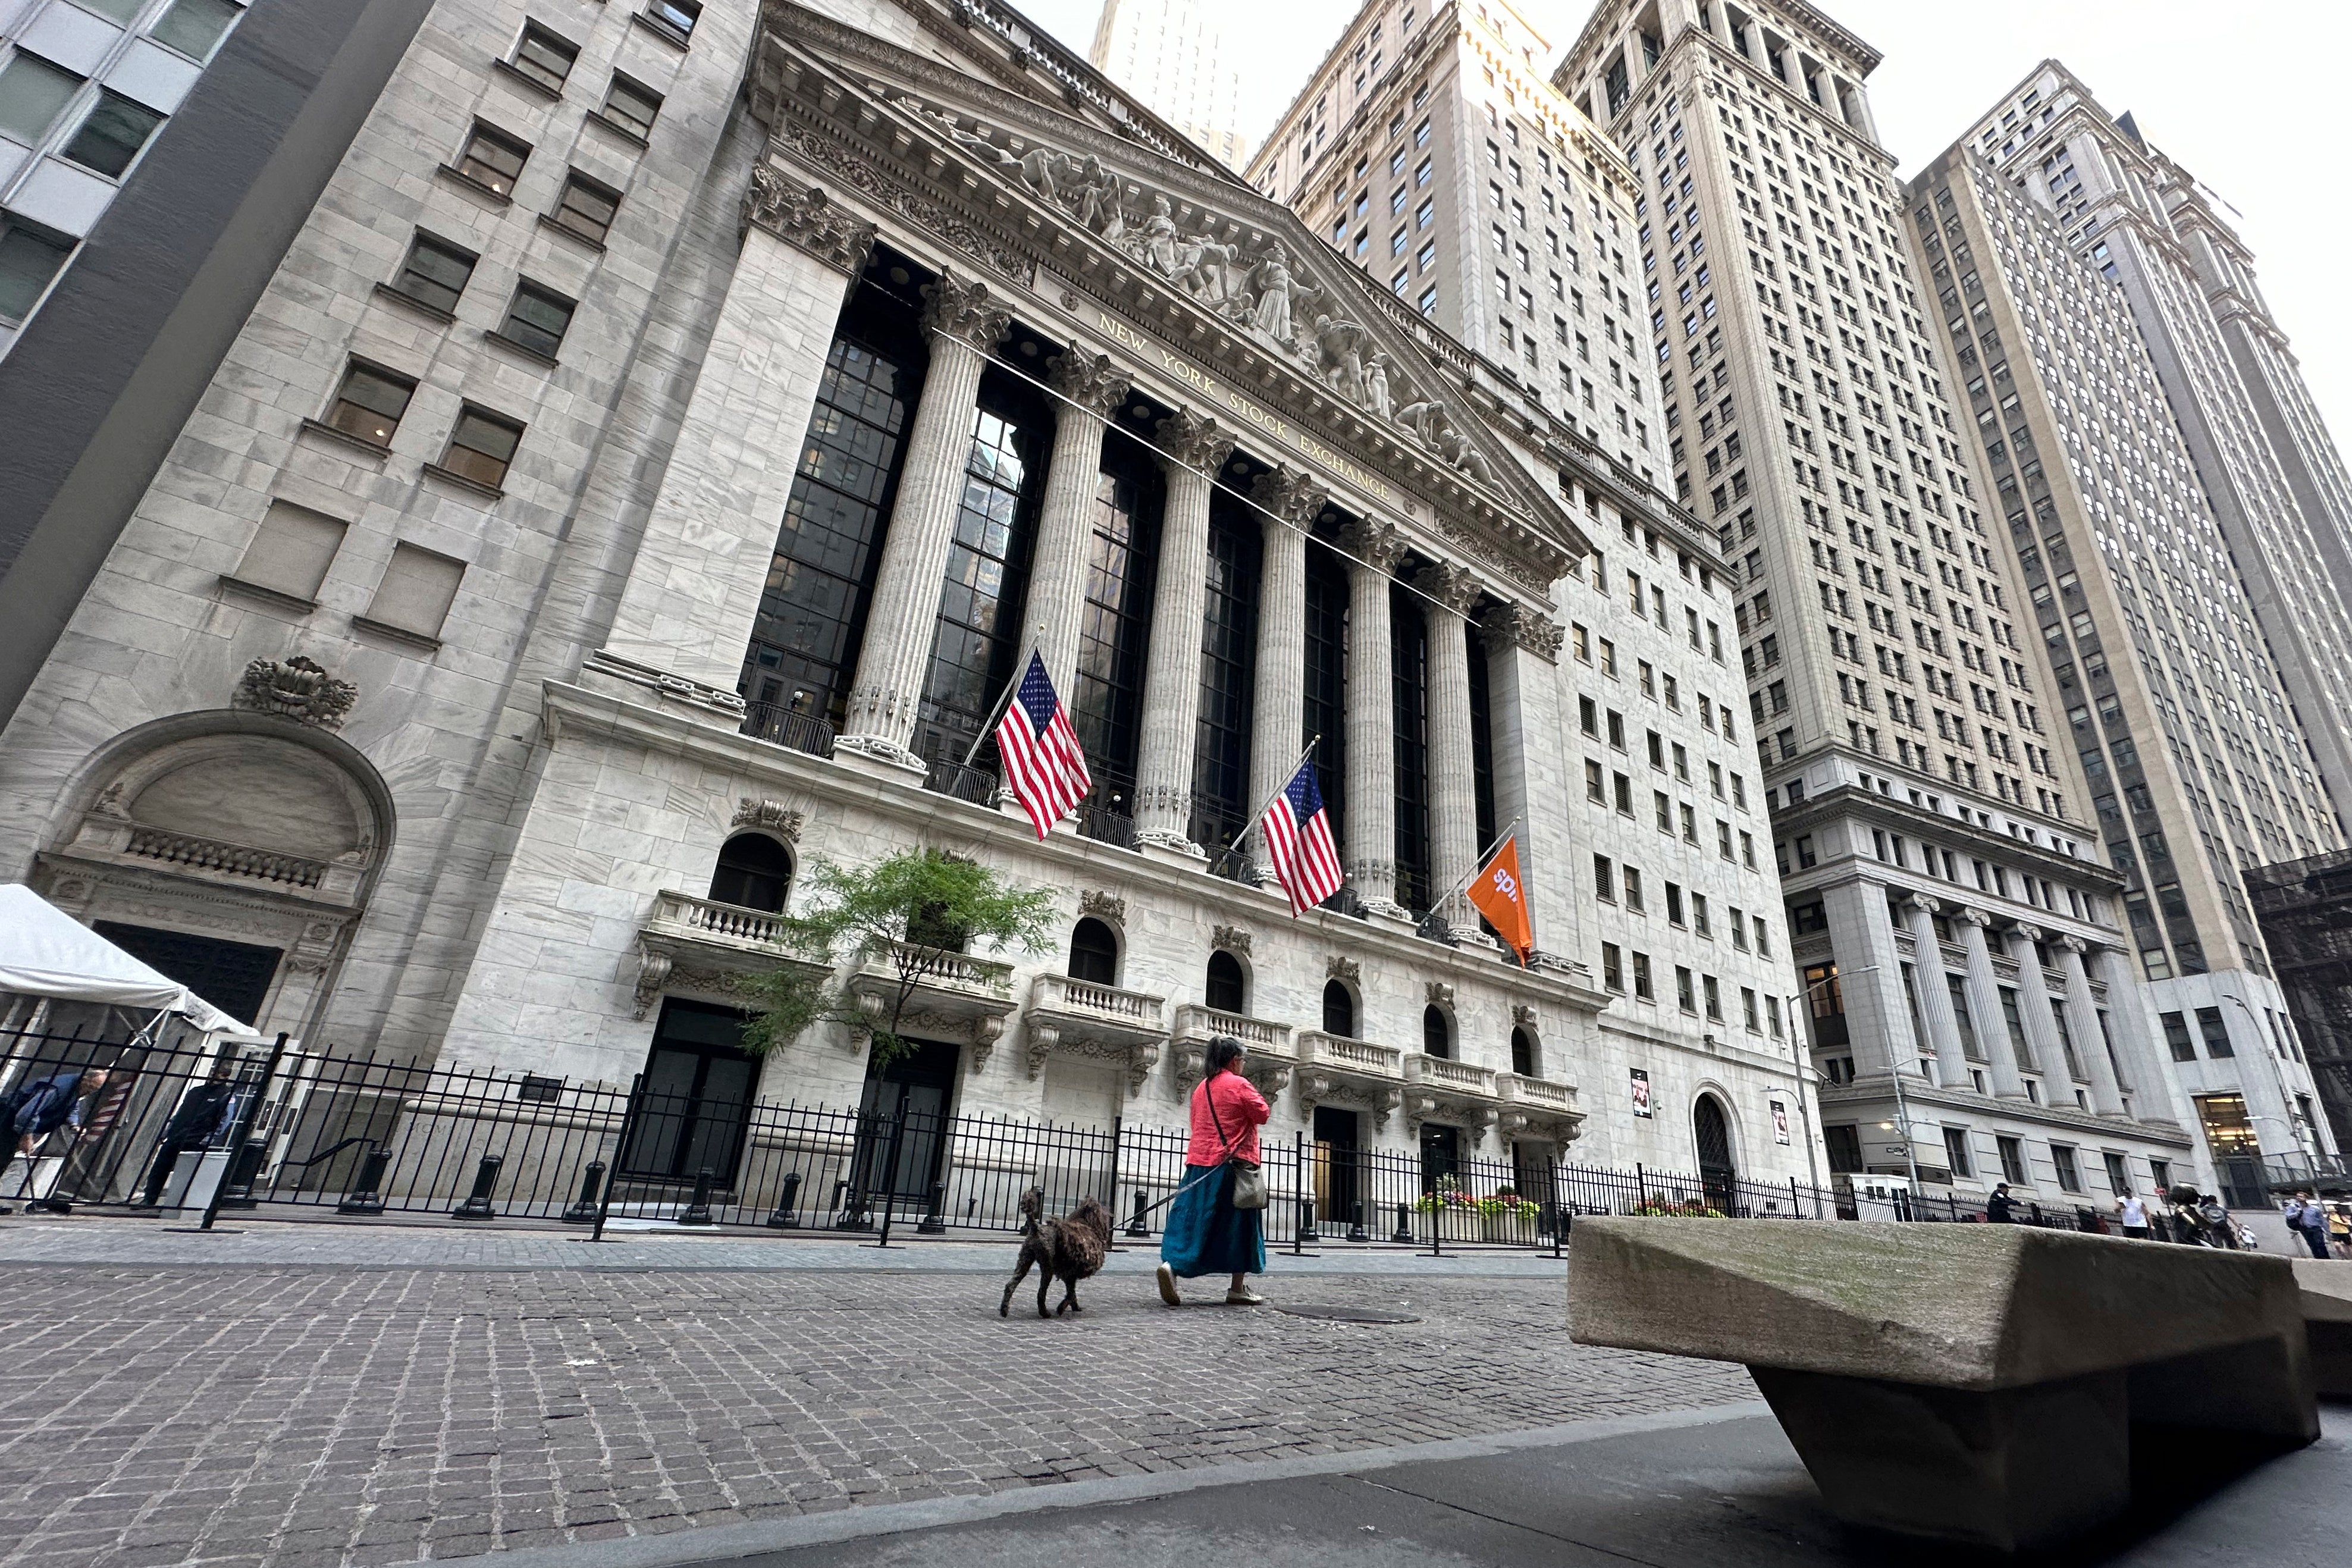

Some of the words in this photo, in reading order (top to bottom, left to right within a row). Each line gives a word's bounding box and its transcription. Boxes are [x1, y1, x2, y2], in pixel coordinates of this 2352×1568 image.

[1098, 312, 1148, 351] NEW
[1160, 349, 1216, 397] YORK
[1228, 393, 1288, 440] STOCK
[1299, 434, 1391, 501] EXCHANGE
